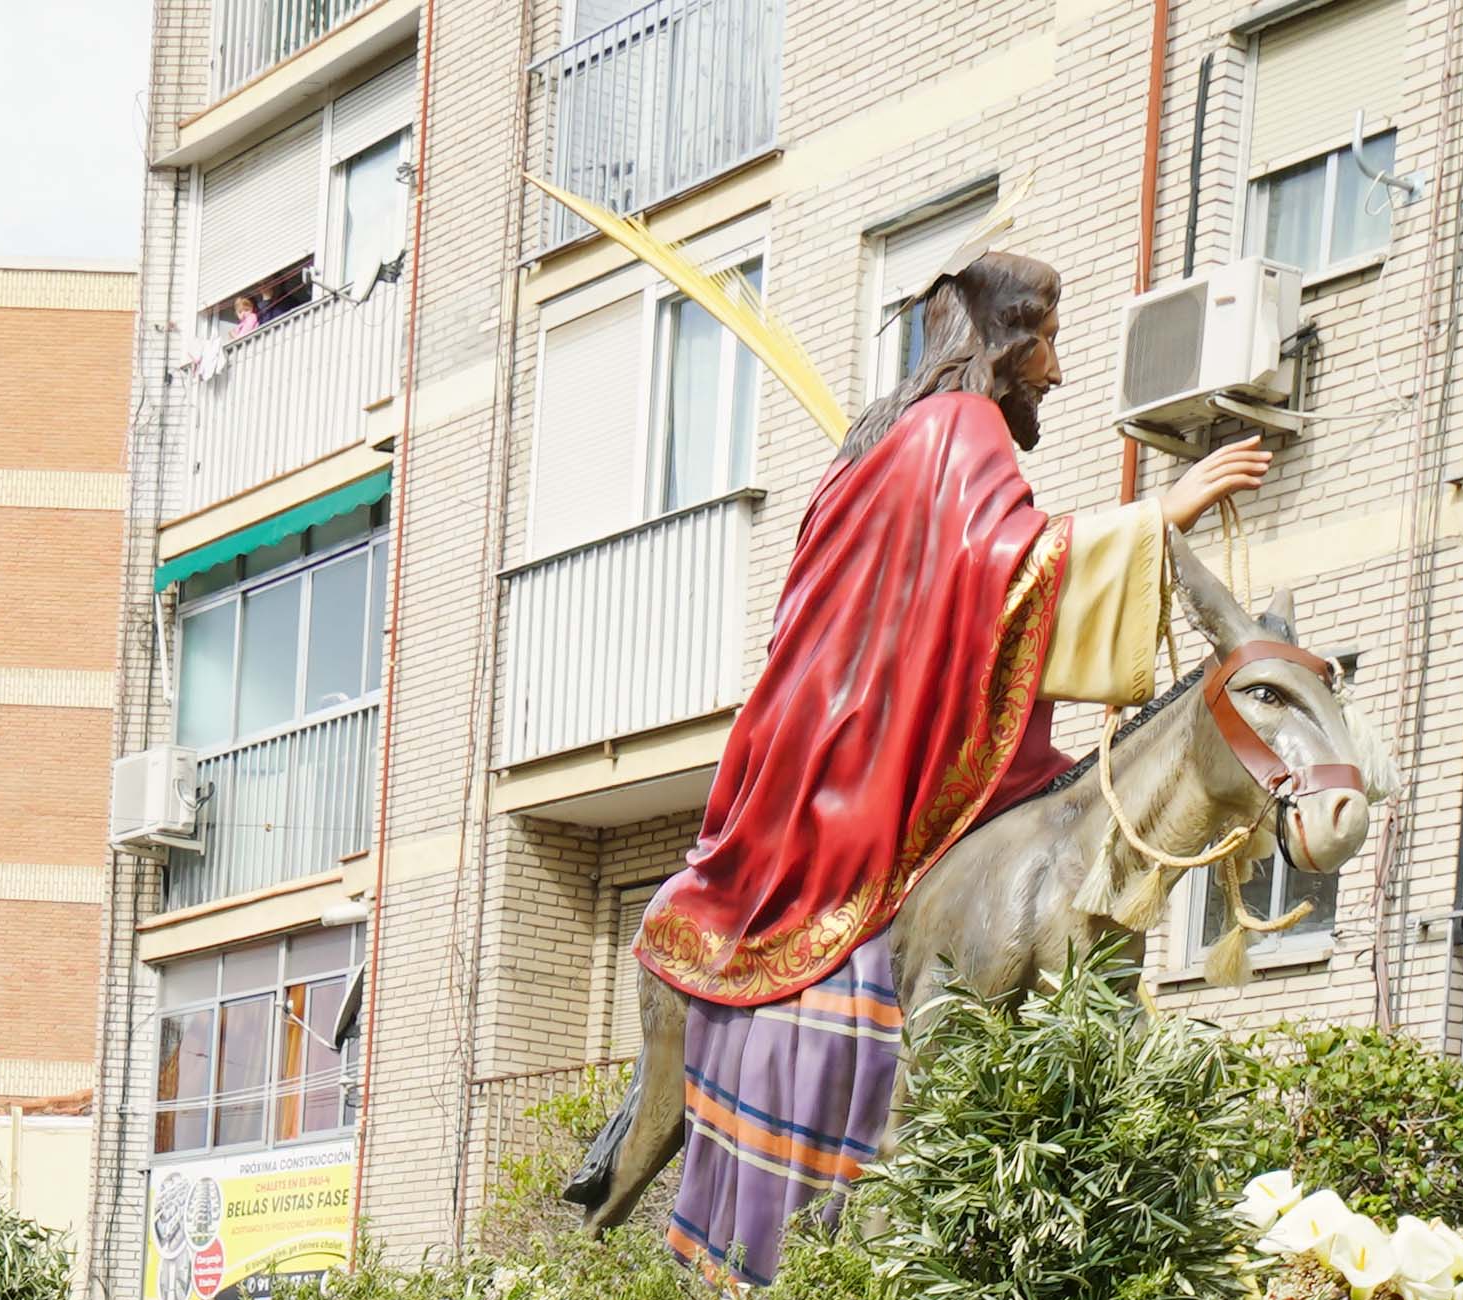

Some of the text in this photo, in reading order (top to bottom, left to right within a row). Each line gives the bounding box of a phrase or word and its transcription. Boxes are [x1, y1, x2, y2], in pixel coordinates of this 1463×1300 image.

[239, 1150, 351, 1175] PRÓXIMA CONSTRUCCIÓN
[227, 1188, 350, 1218] BELLAS VISTAS FASE
